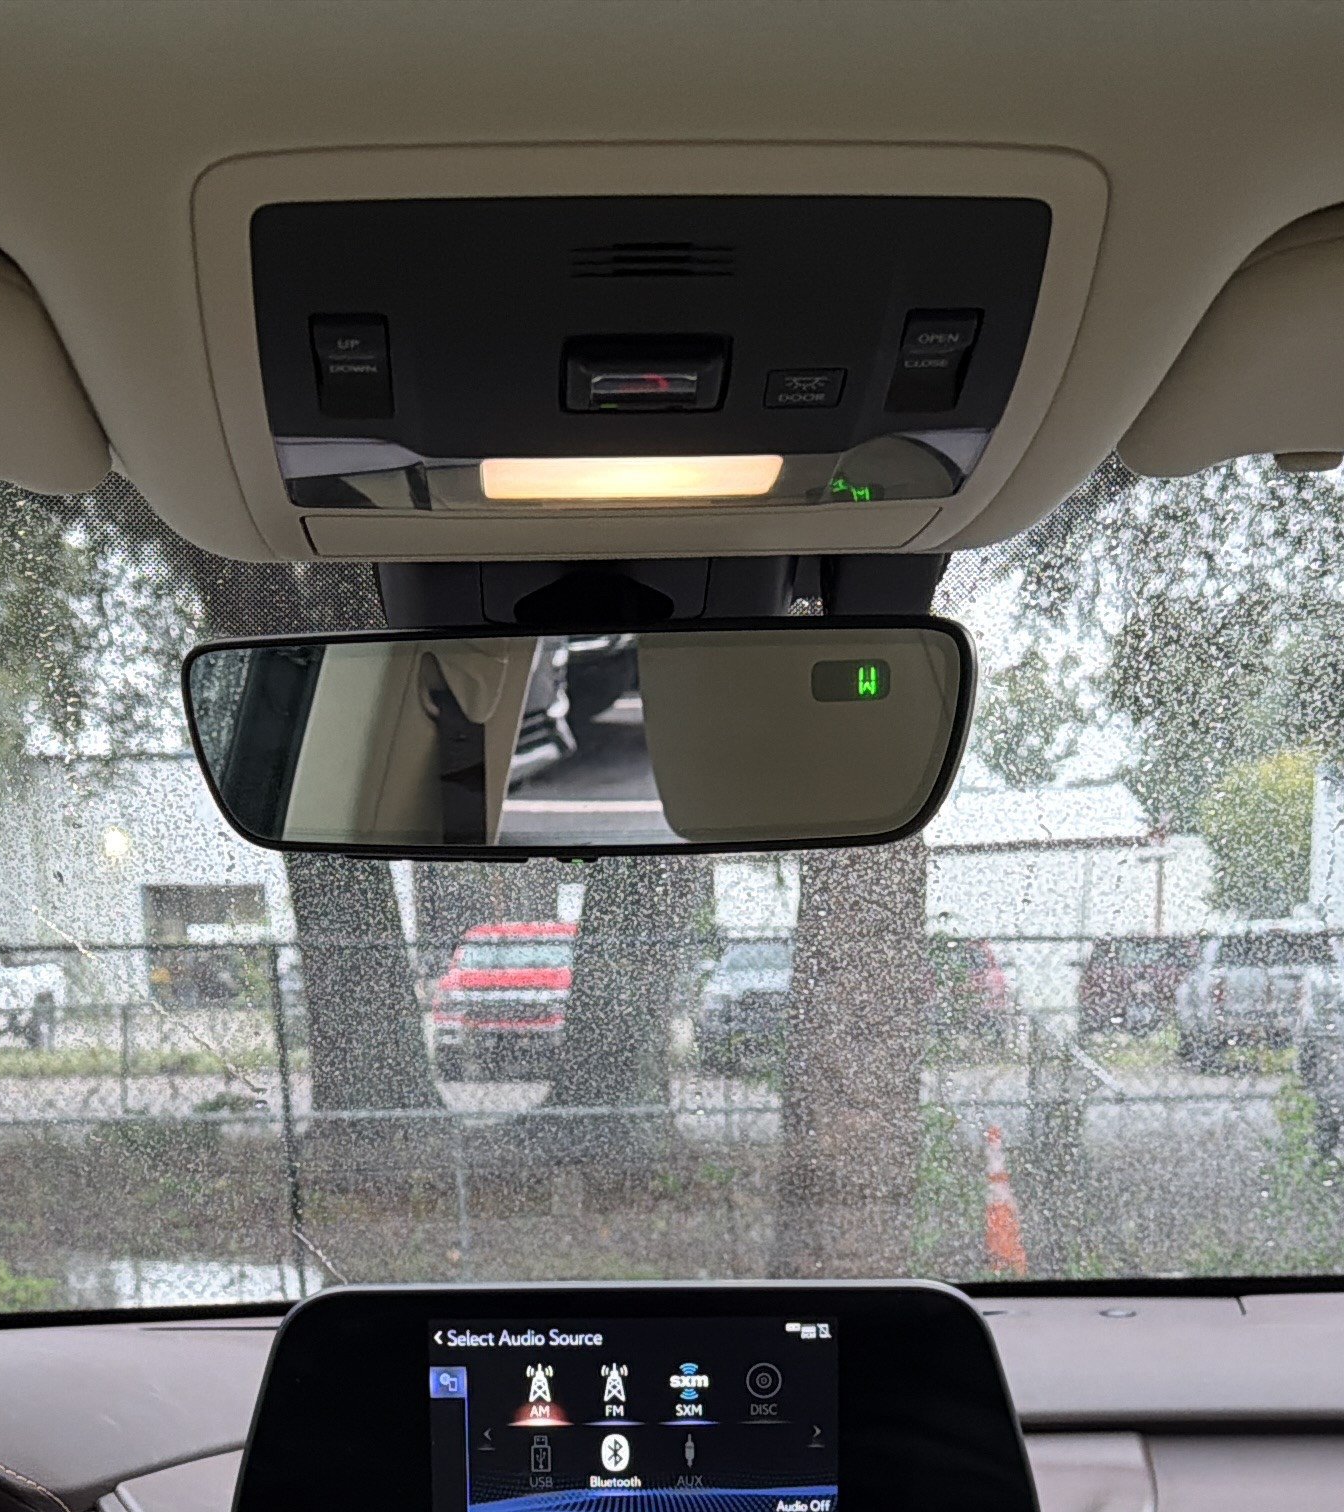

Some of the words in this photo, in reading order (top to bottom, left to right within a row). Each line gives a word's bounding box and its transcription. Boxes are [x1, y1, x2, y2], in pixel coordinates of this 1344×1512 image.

[918, 333, 960, 345] OPEN
[858, 666, 876, 695] W
[447, 1330, 495, 1347] Select
[498, 1329, 546, 1346] Audio
[549, 1329, 603, 1346] Source
[529, 1405, 551, 1418] AM
[605, 1405, 624, 1418] FM
[675, 1404, 703, 1418] SXM
[750, 1403, 778, 1416] DISC
[529, 1476, 554, 1488] USB
[589, 1476, 642, 1488] Bluetooth
[676, 1475, 703, 1488] AUX
[776, 1501, 808, 1512] Audio
[810, 1500, 831, 1512] Off
